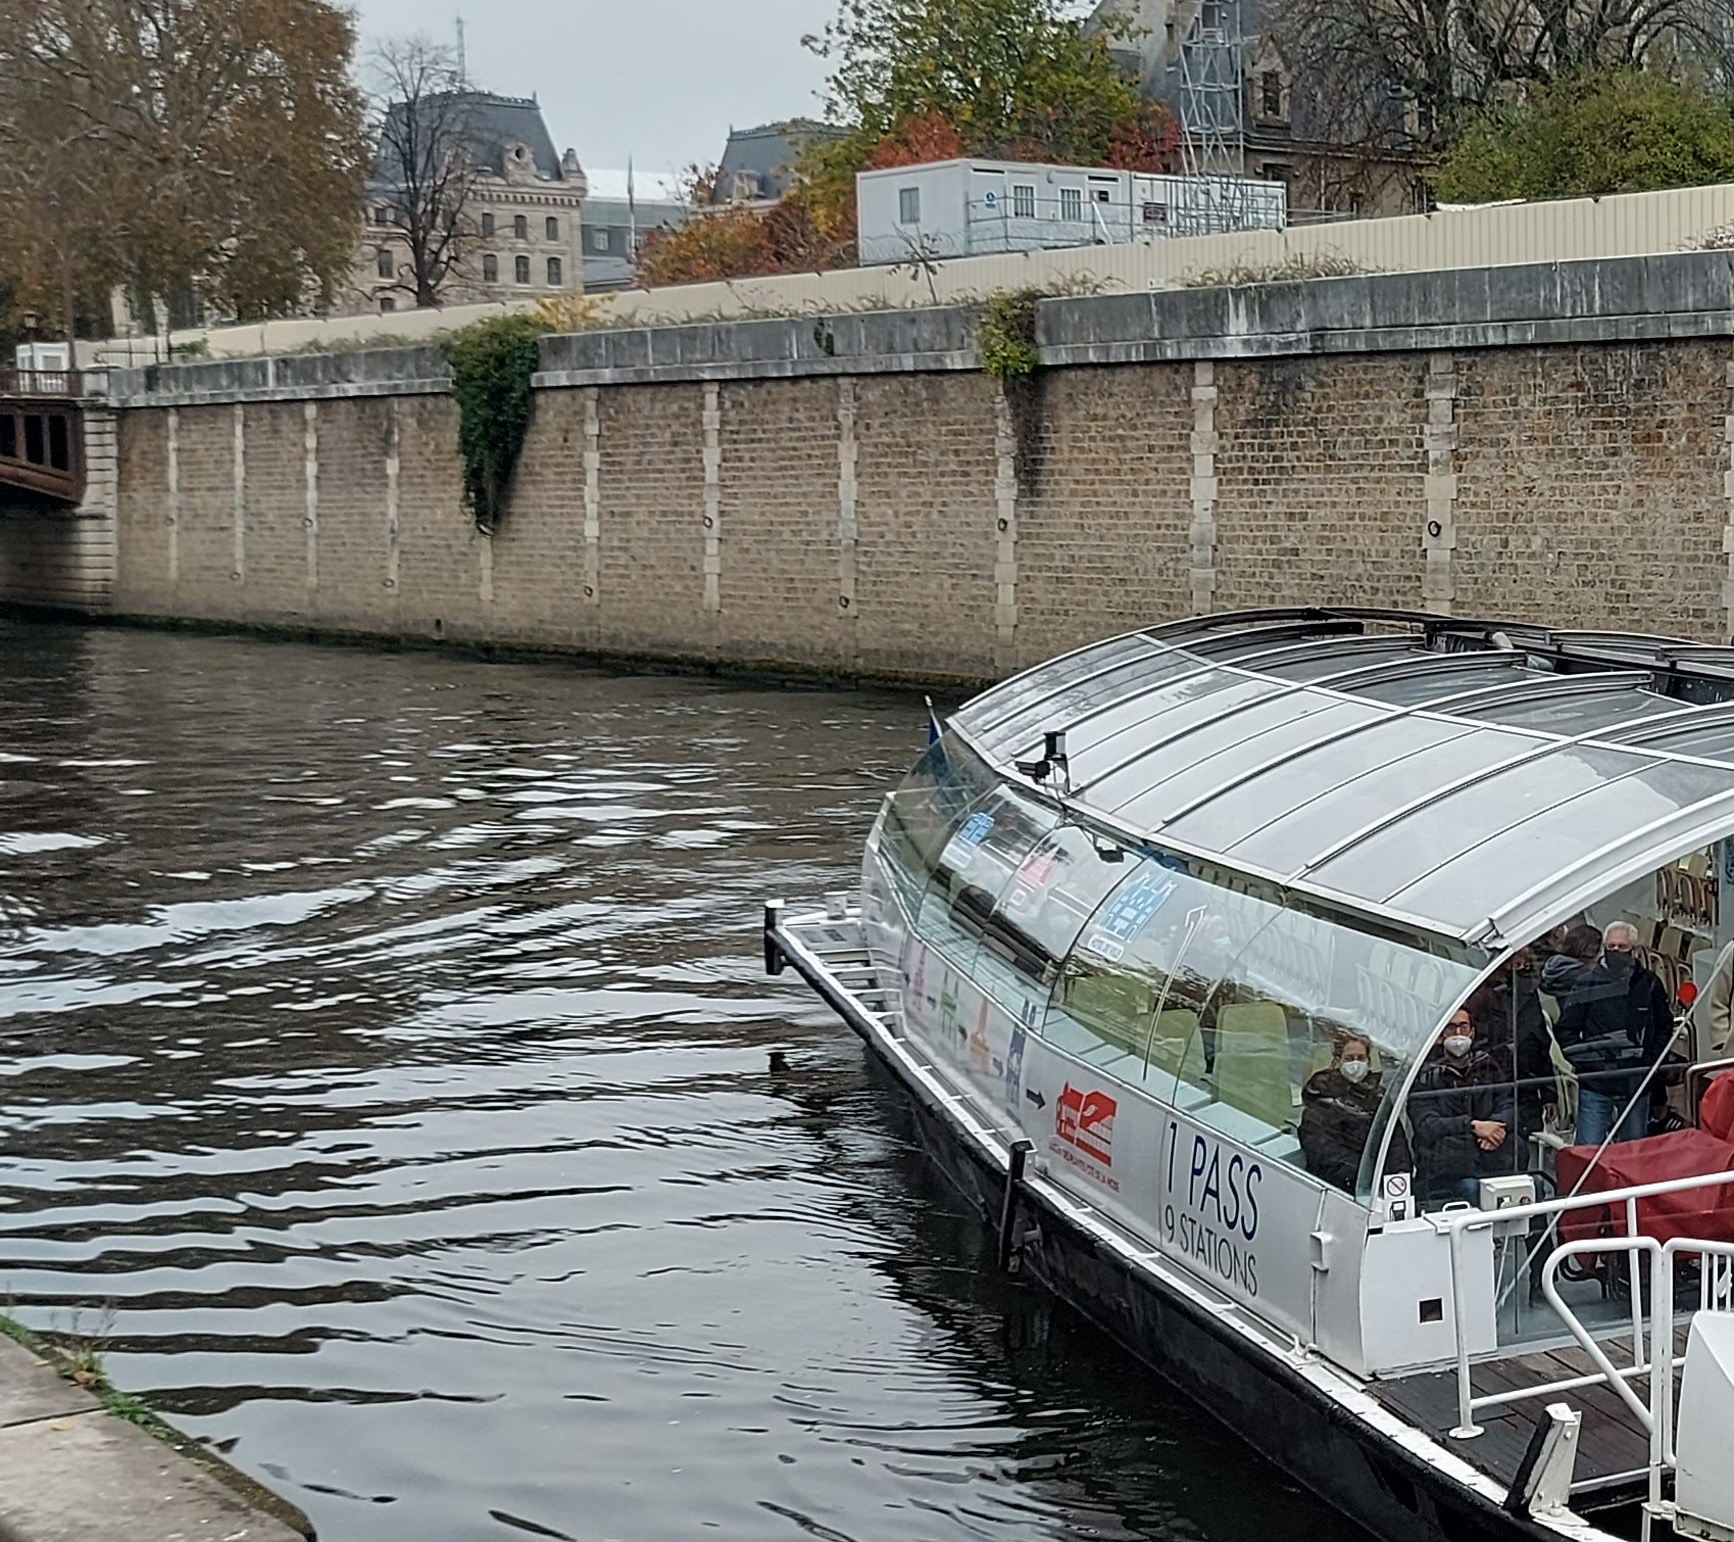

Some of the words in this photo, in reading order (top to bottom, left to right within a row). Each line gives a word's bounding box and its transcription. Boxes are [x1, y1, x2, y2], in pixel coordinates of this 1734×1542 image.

[1169, 1121, 1178, 1193] 1
[1189, 1134, 1262, 1241] PASS
[1165, 1204, 1176, 1243] 9
[1180, 1213, 1258, 1297] STATIONS
